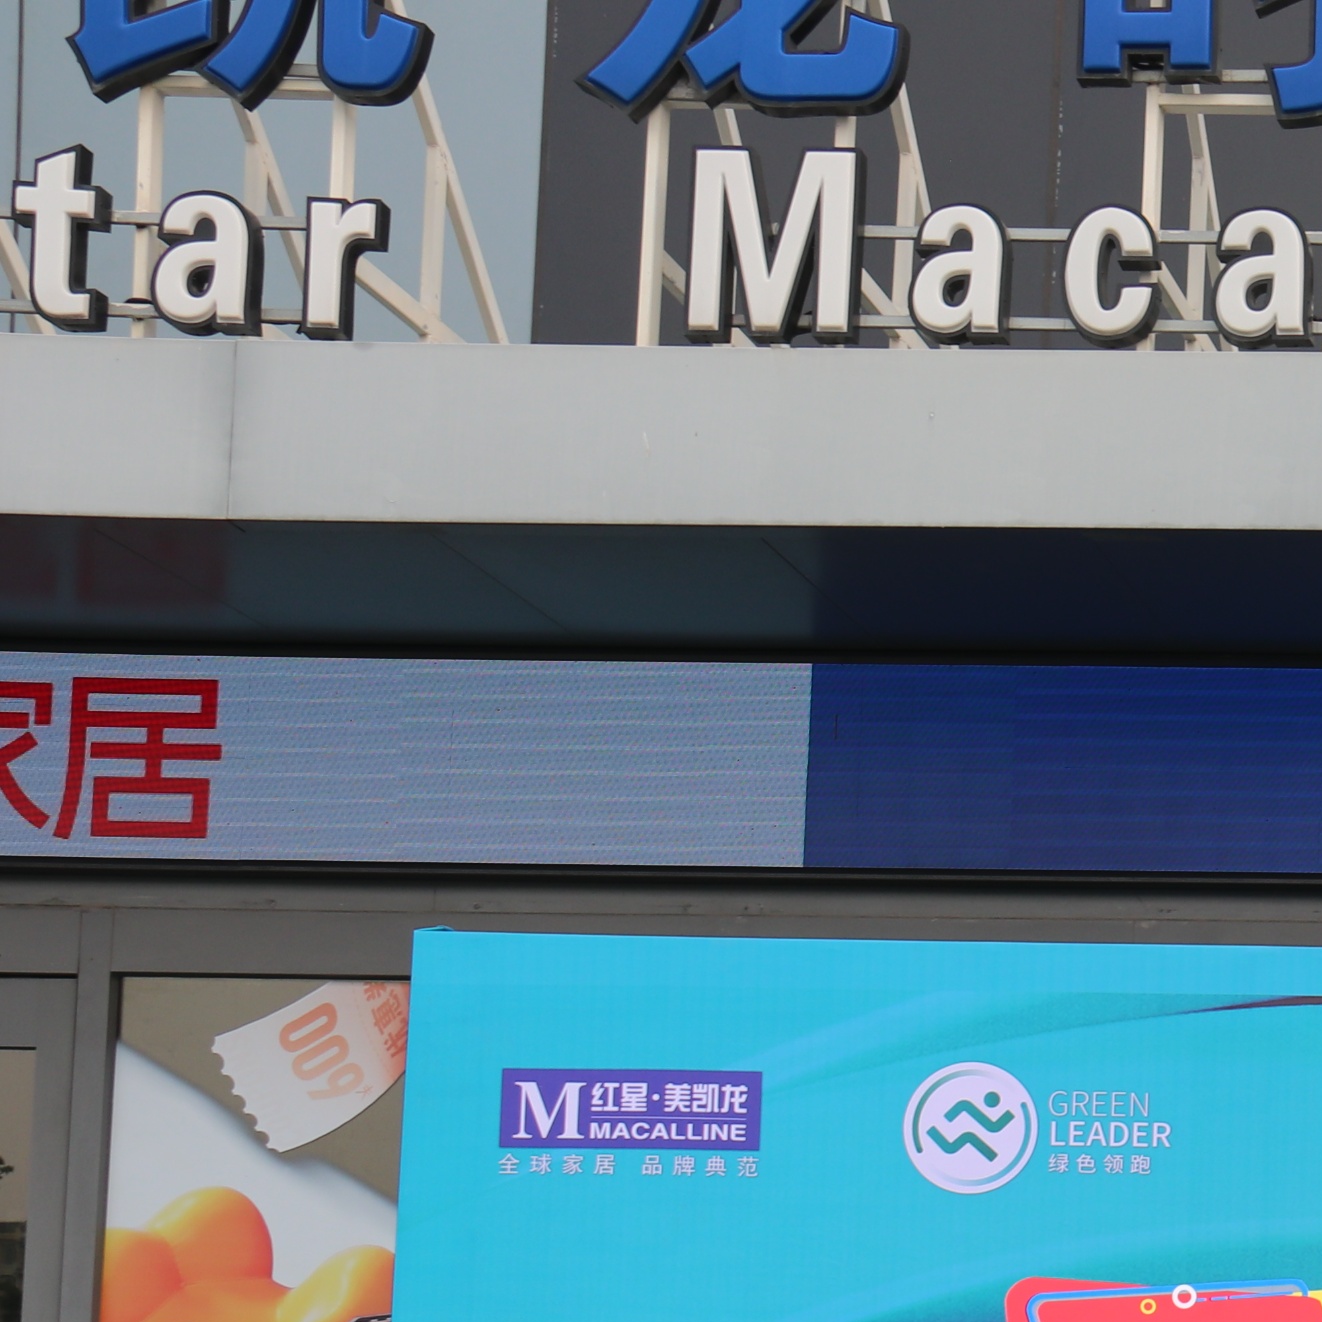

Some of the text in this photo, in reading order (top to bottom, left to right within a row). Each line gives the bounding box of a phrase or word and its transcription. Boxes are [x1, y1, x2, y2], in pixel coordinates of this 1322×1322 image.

[1048, 1090, 1151, 1117] GREEN
[589, 1122, 747, 1142] MACALLINE
[1049, 1121, 1172, 1148] LEADER
[498, 1153, 760, 1178] 全球家居 品牌典范
[1048, 1153, 1153, 1176] 绿色领跑
